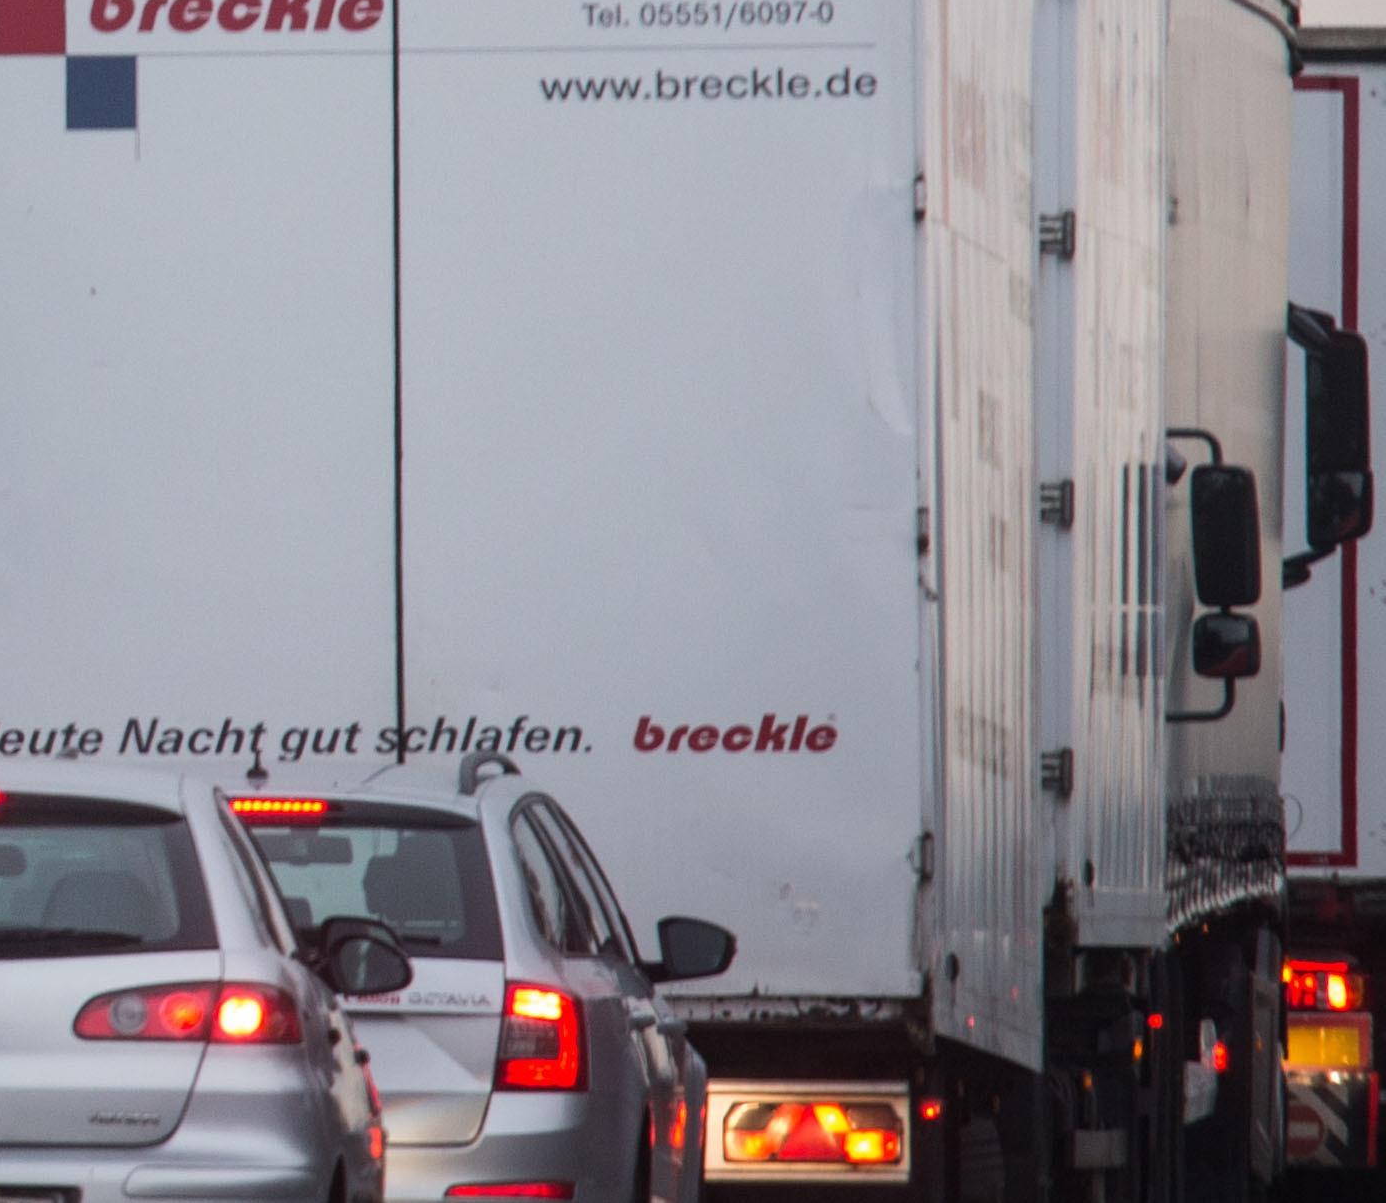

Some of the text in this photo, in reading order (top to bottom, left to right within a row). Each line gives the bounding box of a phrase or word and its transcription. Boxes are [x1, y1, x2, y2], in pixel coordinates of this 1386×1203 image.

[582, 0, 834, 31] Tel. 05551/6097-0
[540, 67, 879, 101] www.breckle.de
[119, 716, 266, 756] Nacht
[279, 722, 362, 762] gut
[374, 715, 594, 755] schlafen.
[633, 712, 839, 754] breckle
